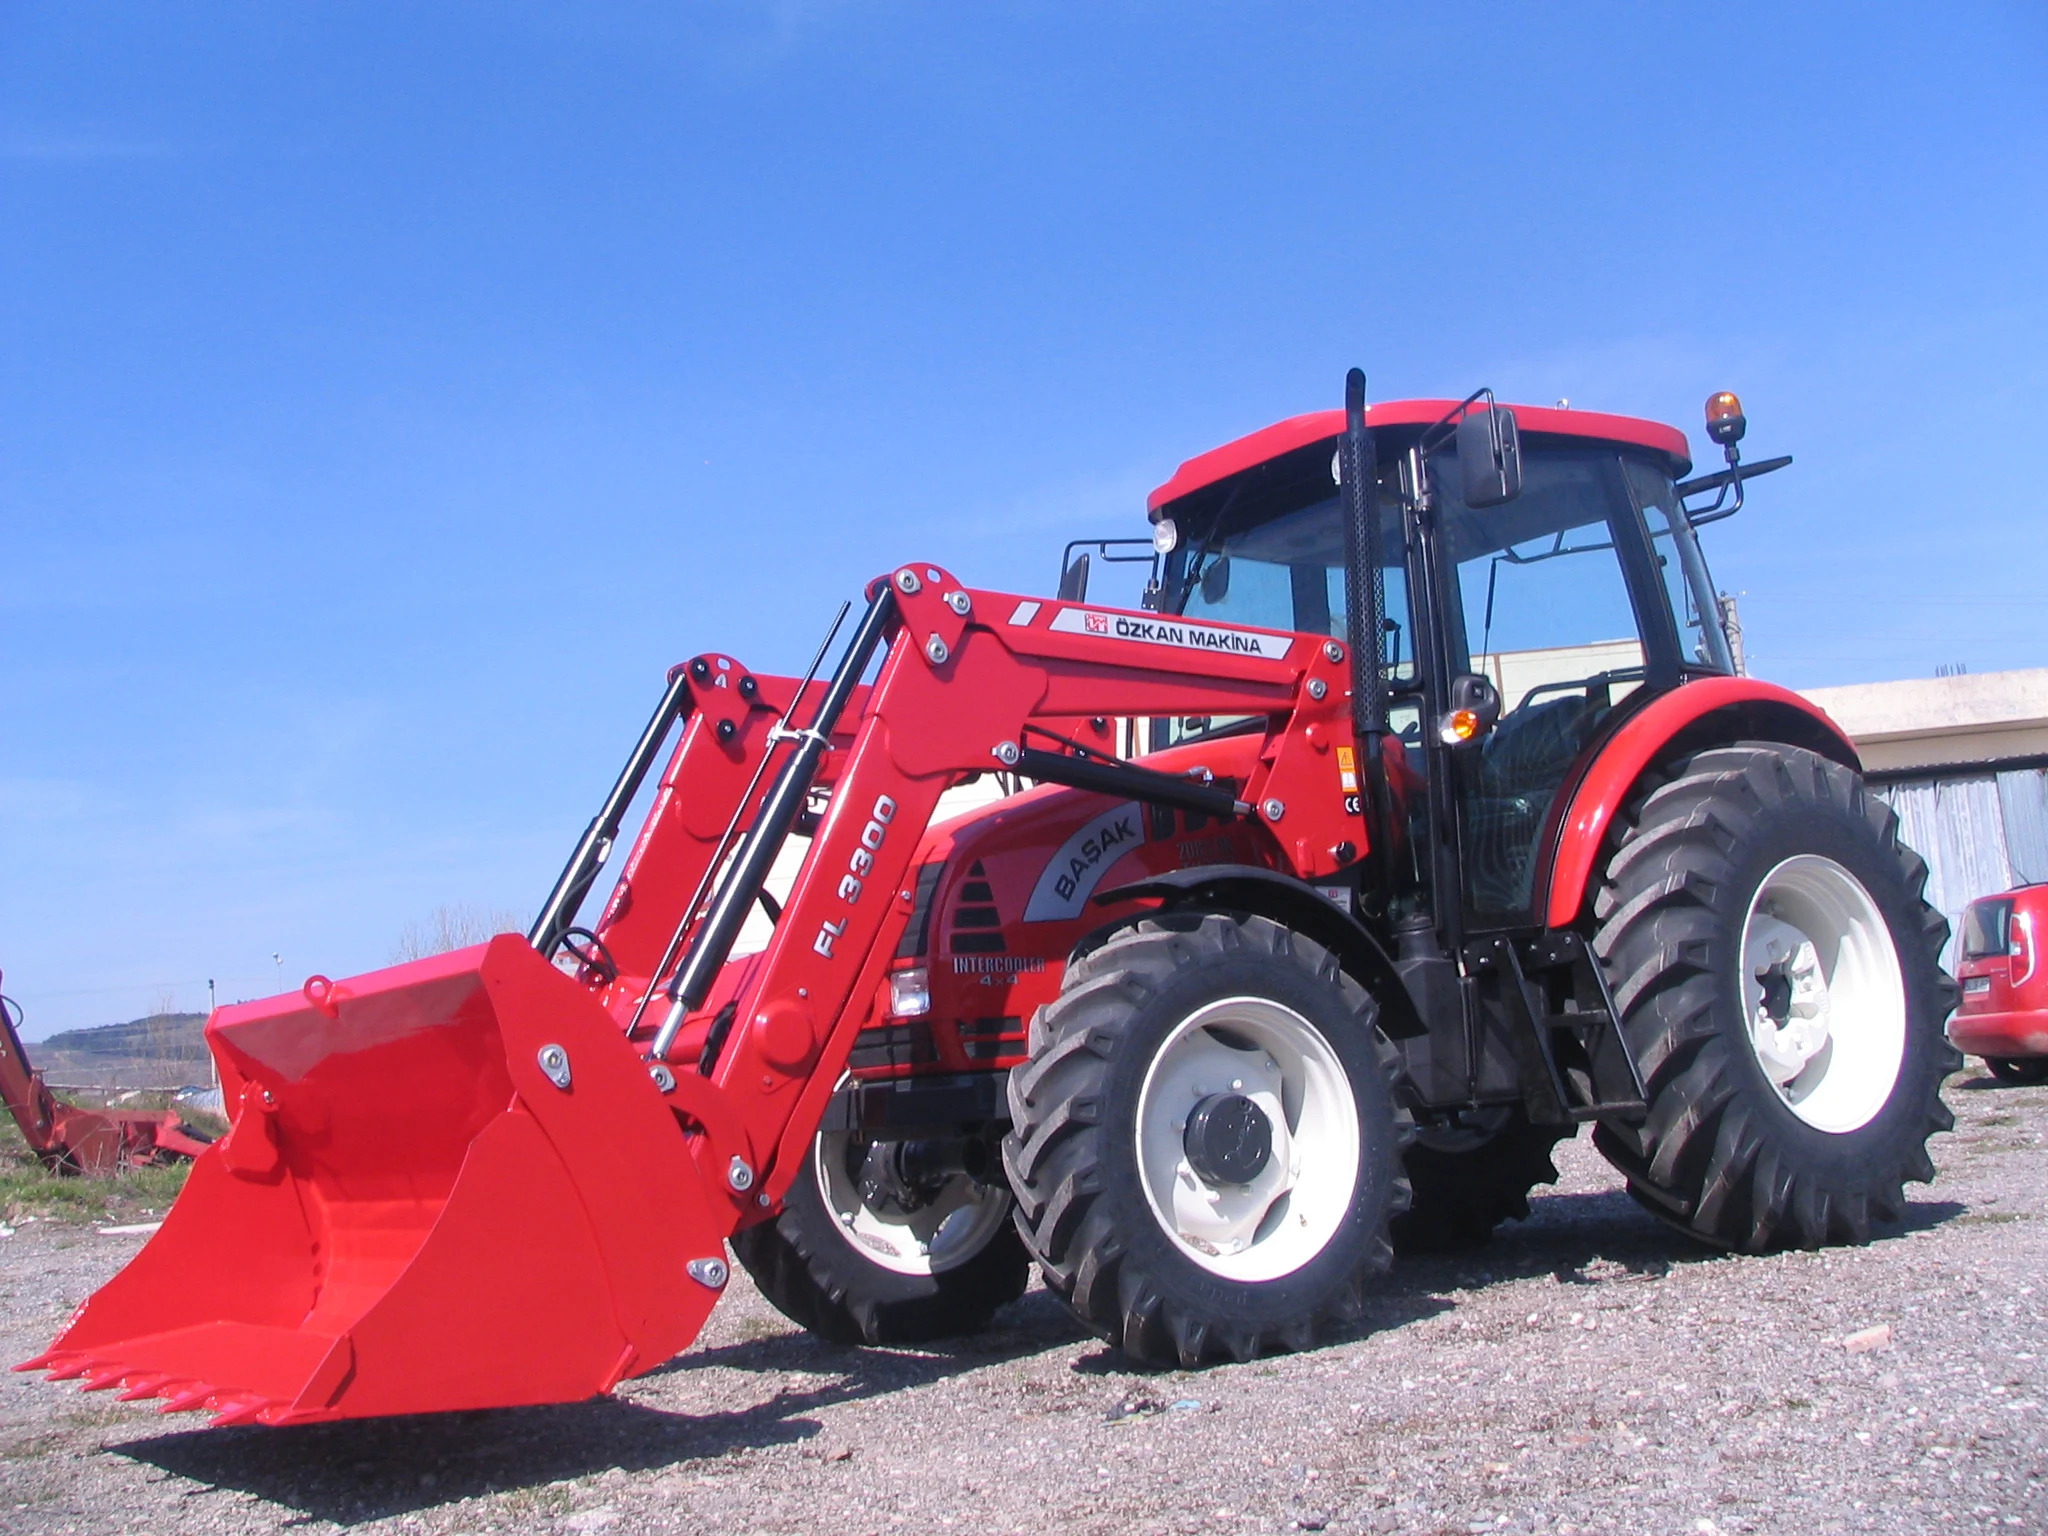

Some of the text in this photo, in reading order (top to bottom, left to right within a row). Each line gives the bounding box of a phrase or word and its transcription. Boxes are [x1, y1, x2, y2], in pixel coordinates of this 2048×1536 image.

[1116, 617, 1262, 654] ÖZKAN MAKİNA
[812, 793, 899, 960] FL 3300
[1054, 816, 1136, 902] BAŞAK
[953, 957, 1046, 973] INTERCOOLER
